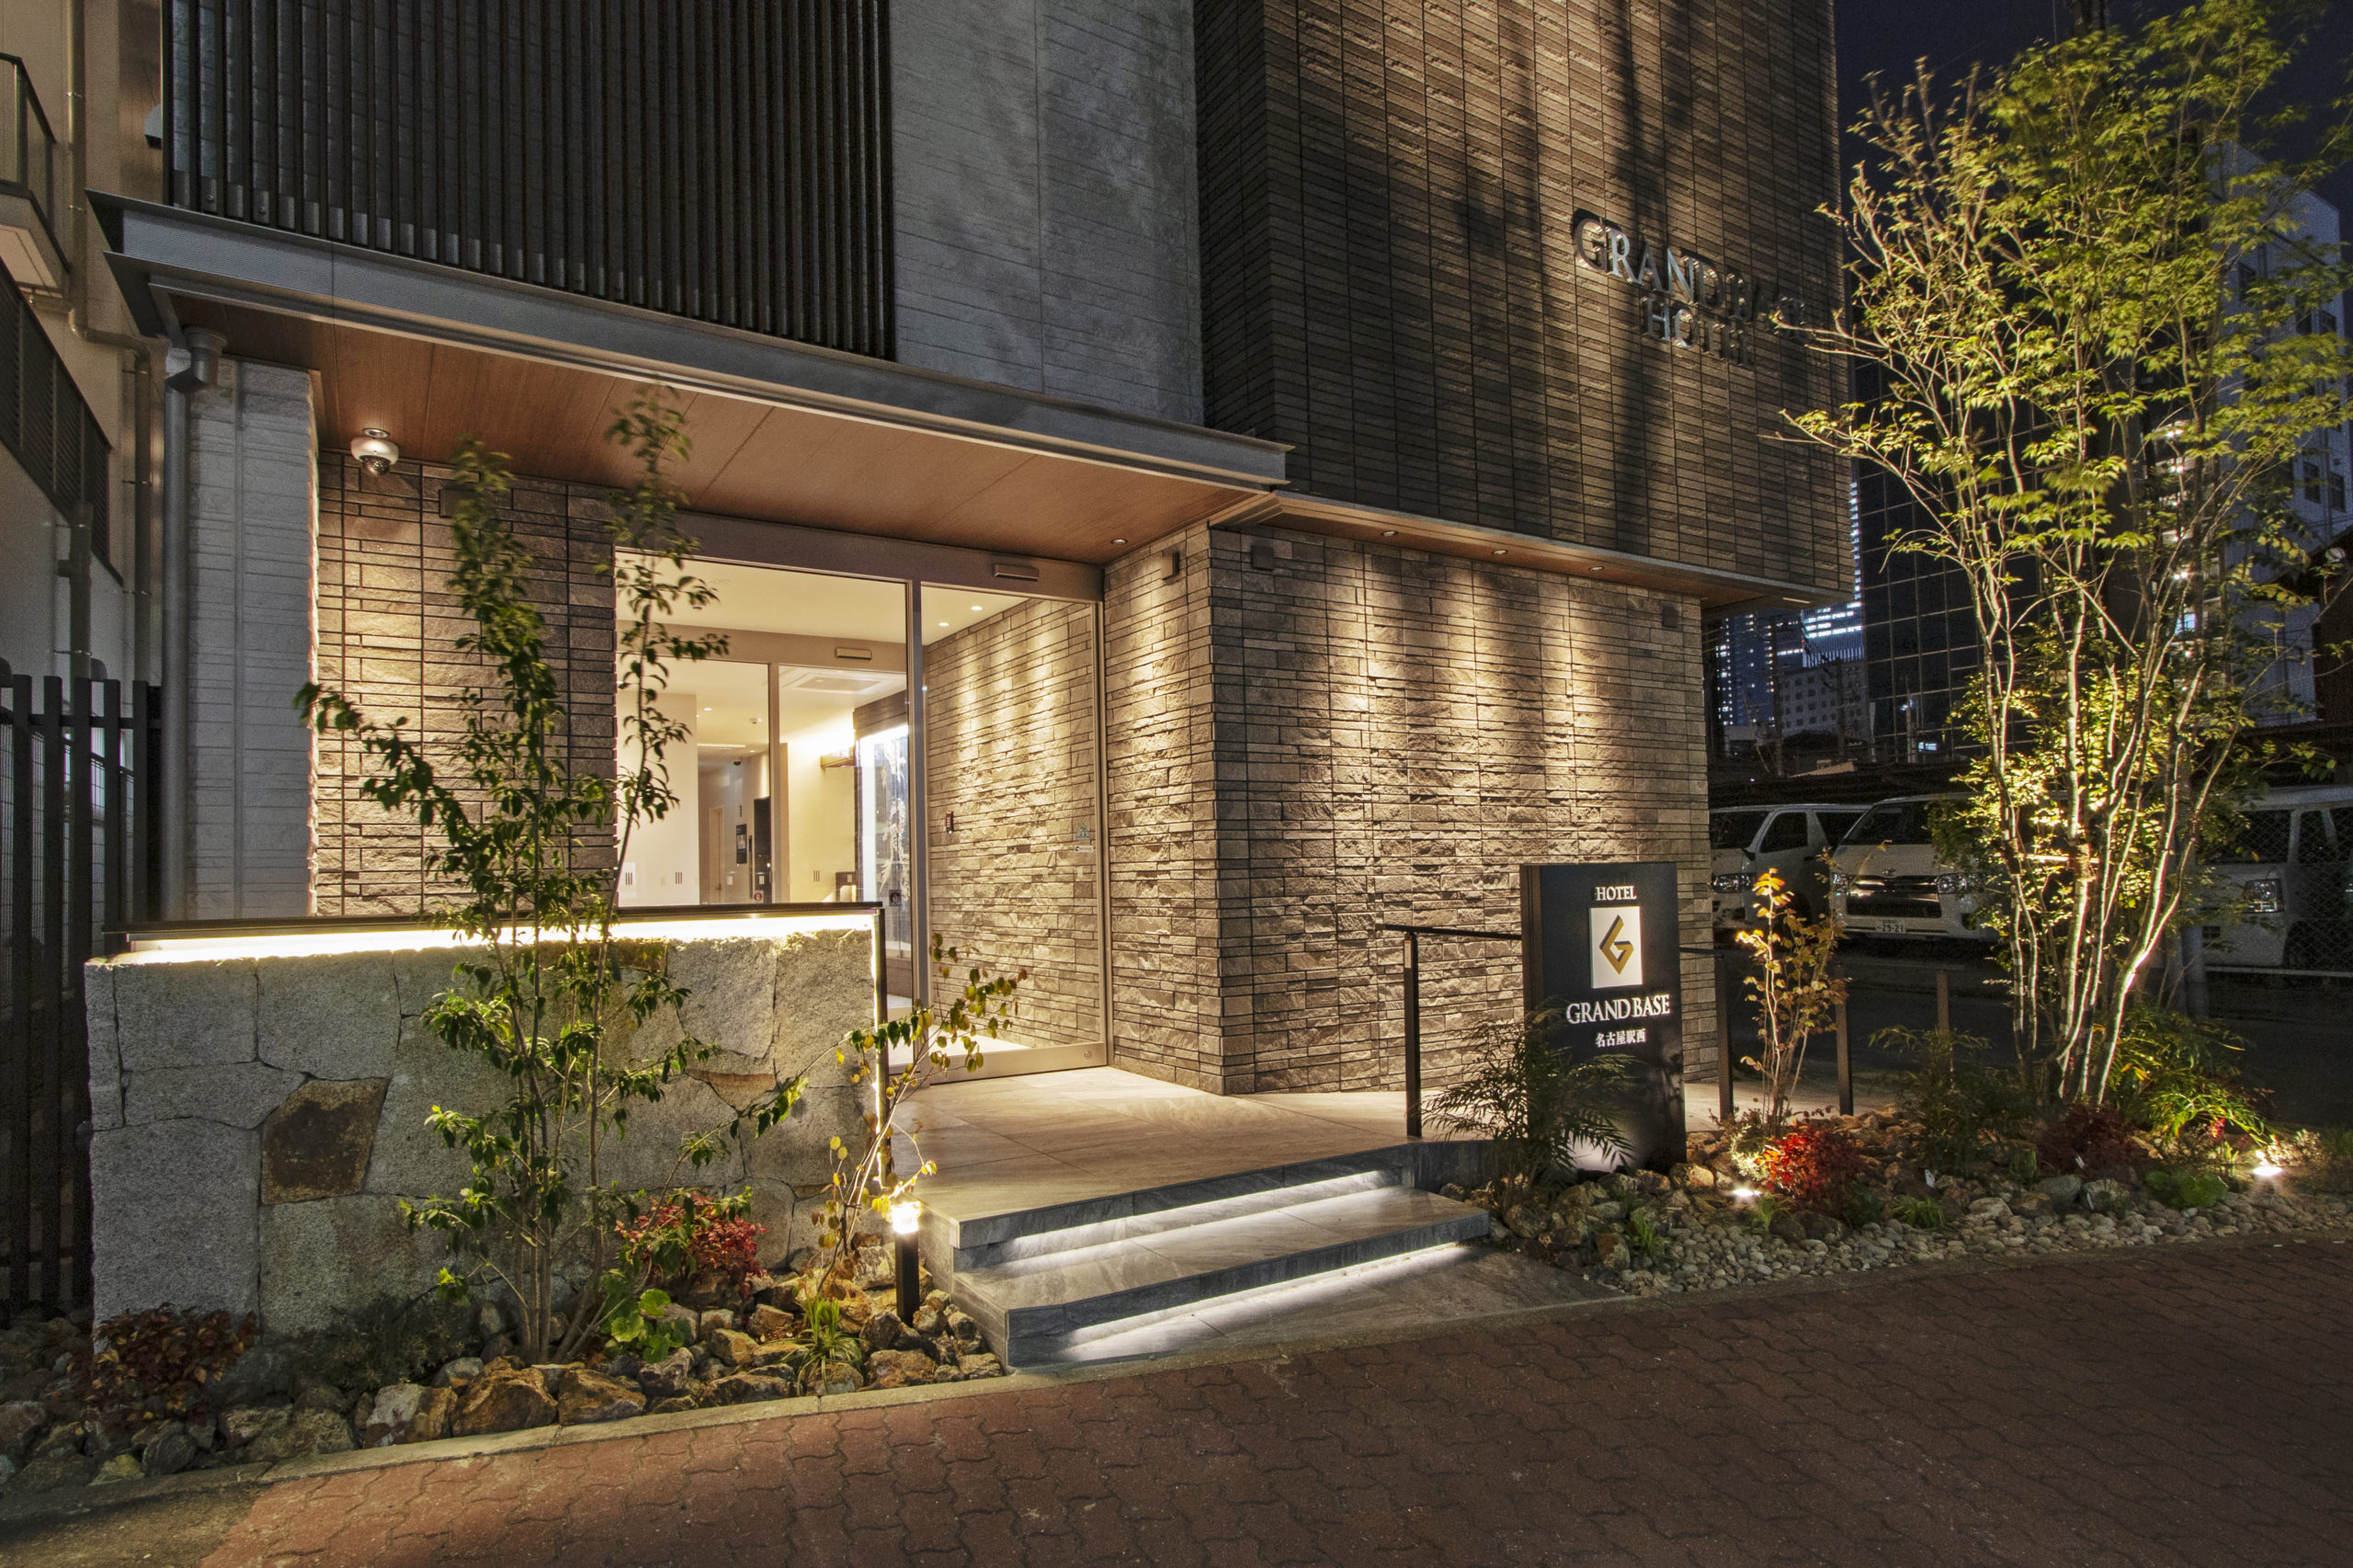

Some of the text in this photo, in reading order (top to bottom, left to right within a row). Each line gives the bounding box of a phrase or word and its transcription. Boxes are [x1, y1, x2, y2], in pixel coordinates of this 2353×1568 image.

[1595, 885, 1638, 902] HOTEL
[1595, 1028, 1647, 1048] 名古屋駅西
